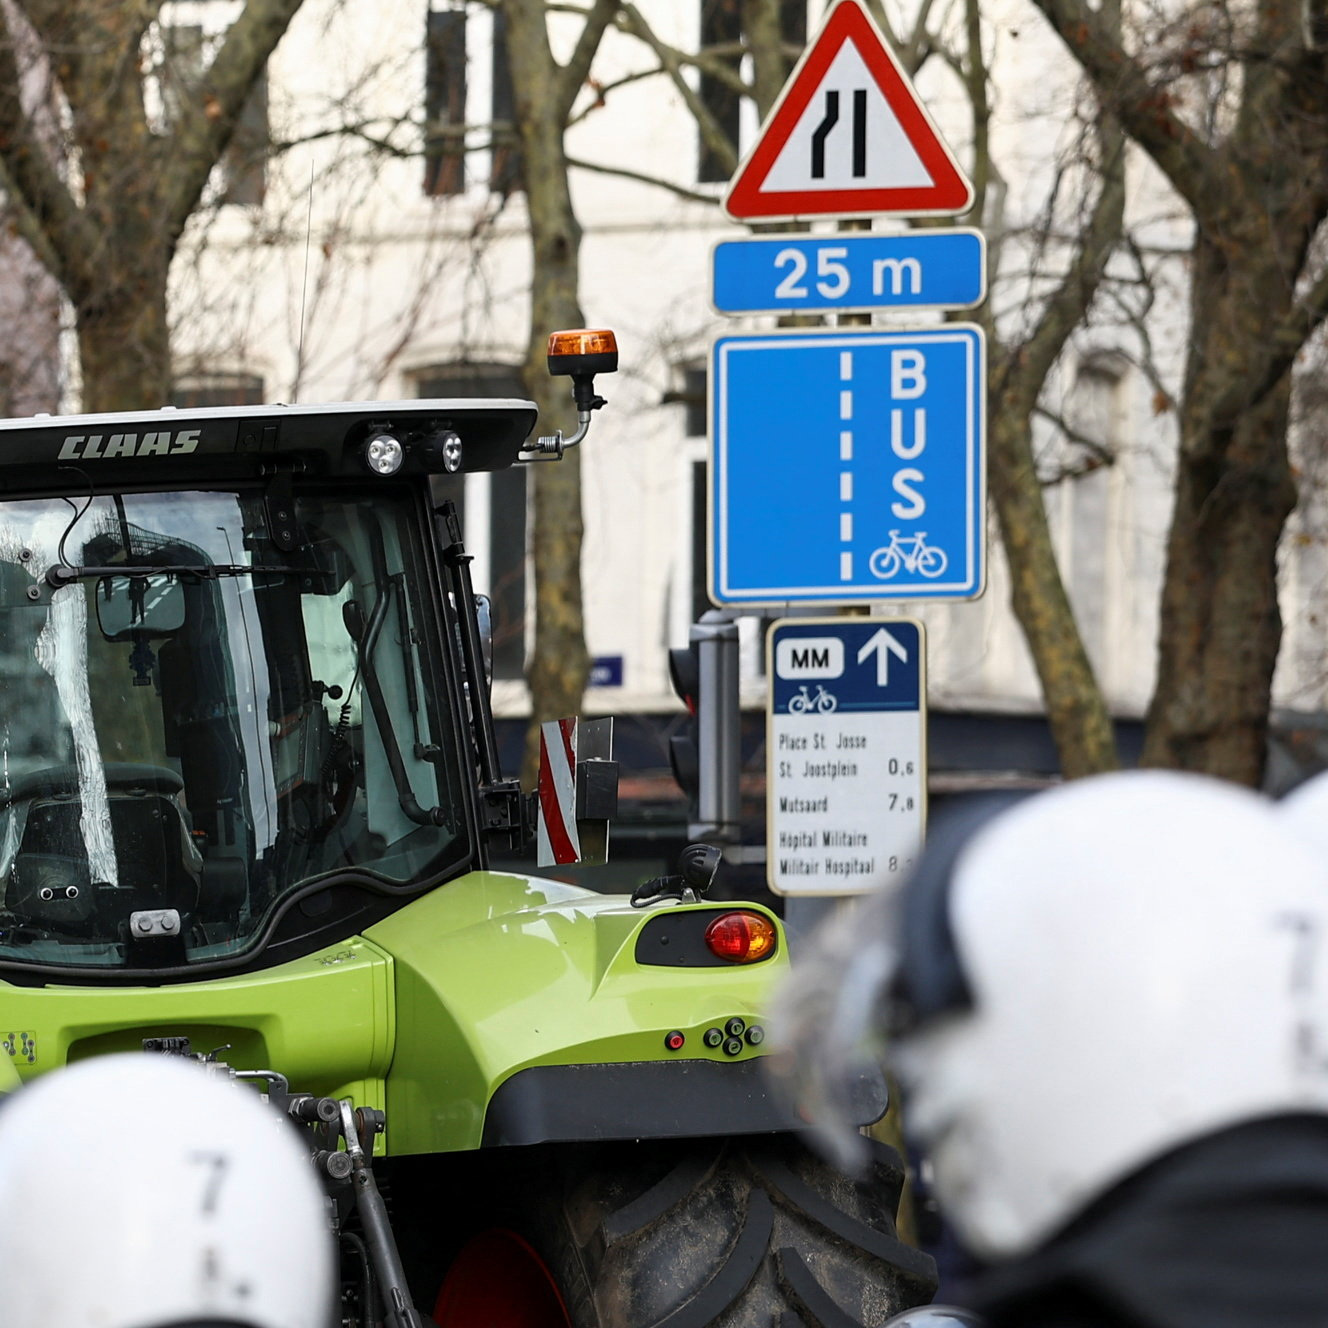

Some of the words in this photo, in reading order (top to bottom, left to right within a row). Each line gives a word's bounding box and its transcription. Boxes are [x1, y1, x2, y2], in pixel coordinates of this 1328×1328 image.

[774, 247, 851, 299] 25
[872, 256, 922, 295] m
[57, 429, 202, 460] CLAAS
[890, 349, 928, 520] BUS
[791, 648, 830, 669] MM
[779, 733, 807, 750] Place
[836, 732, 867, 750] Josse
[803, 760, 858, 781] Joostplein
[779, 796, 828, 814] Mutsaard
[823, 830, 868, 847] Militaire
[779, 858, 819, 875] Militair
[825, 857, 875, 878] Hospitaal
